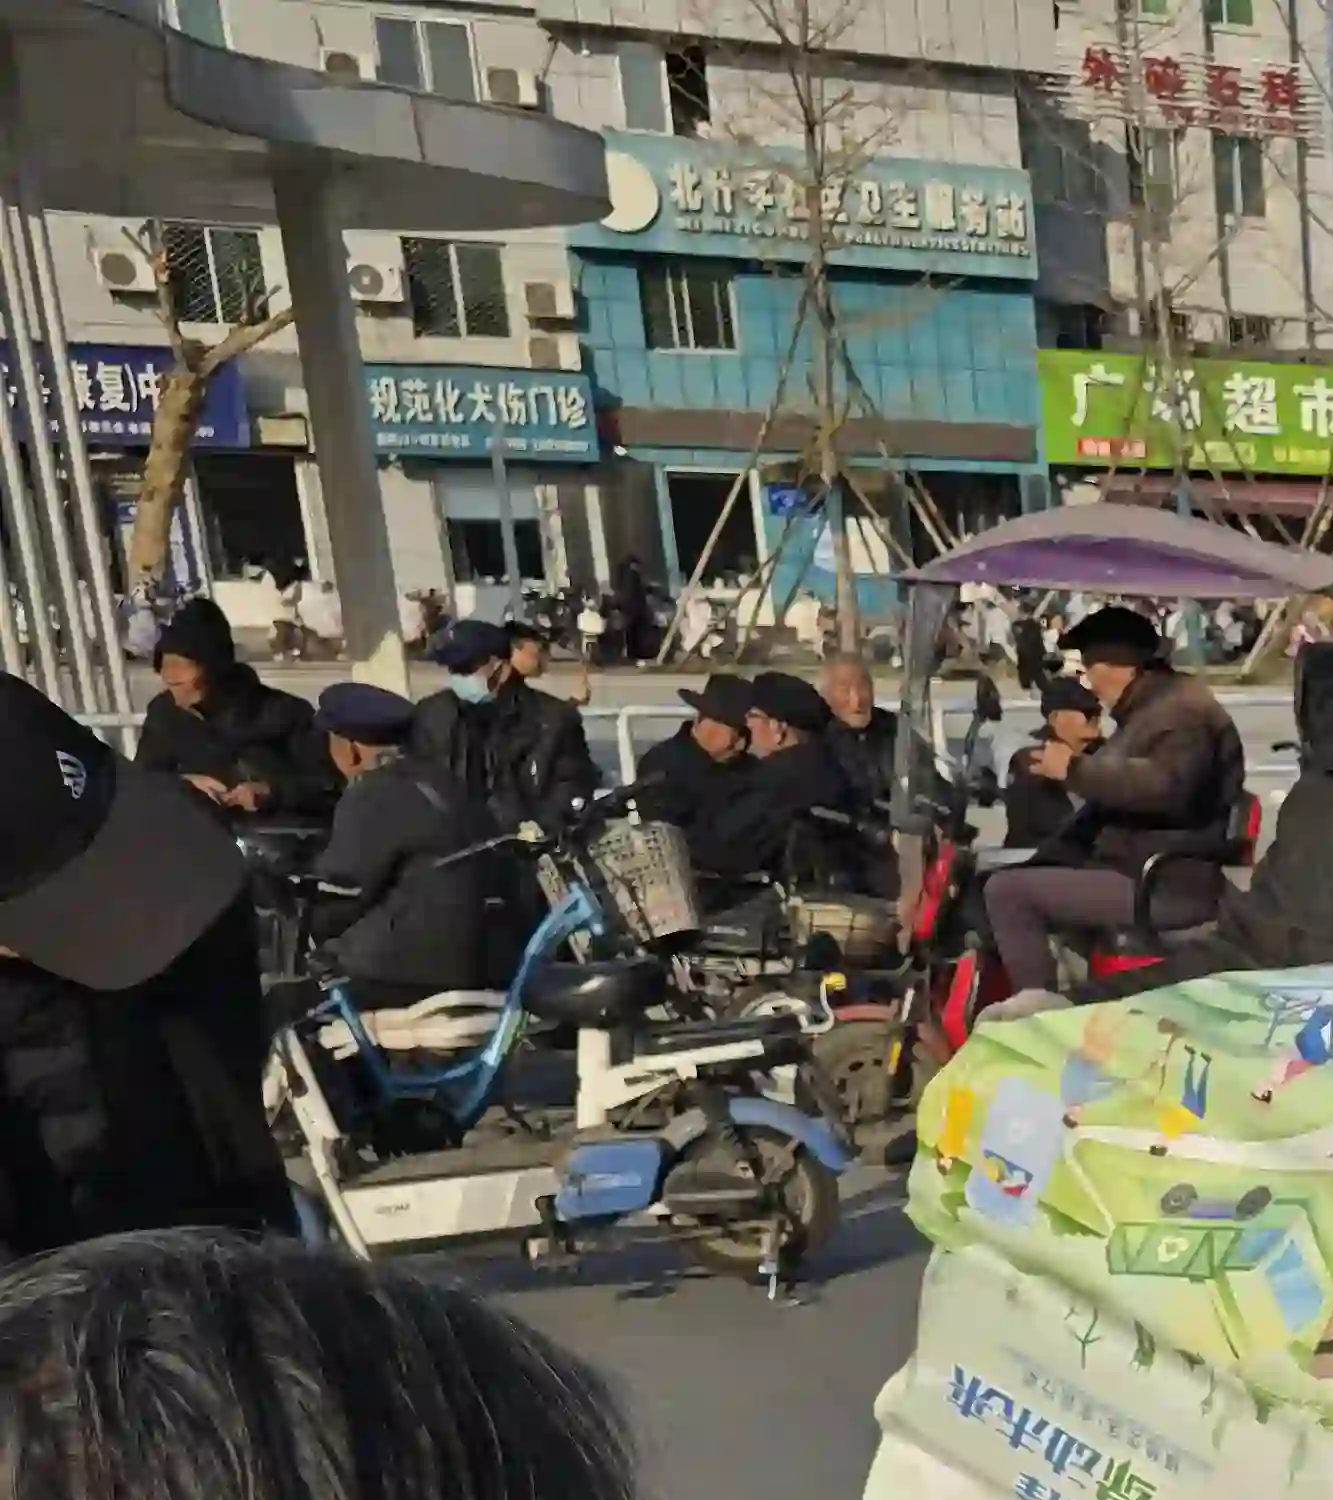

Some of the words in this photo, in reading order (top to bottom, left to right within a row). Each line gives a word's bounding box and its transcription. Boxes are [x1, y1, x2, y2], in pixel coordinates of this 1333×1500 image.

[370, 376, 588, 429] 规范化犬伤门诊
